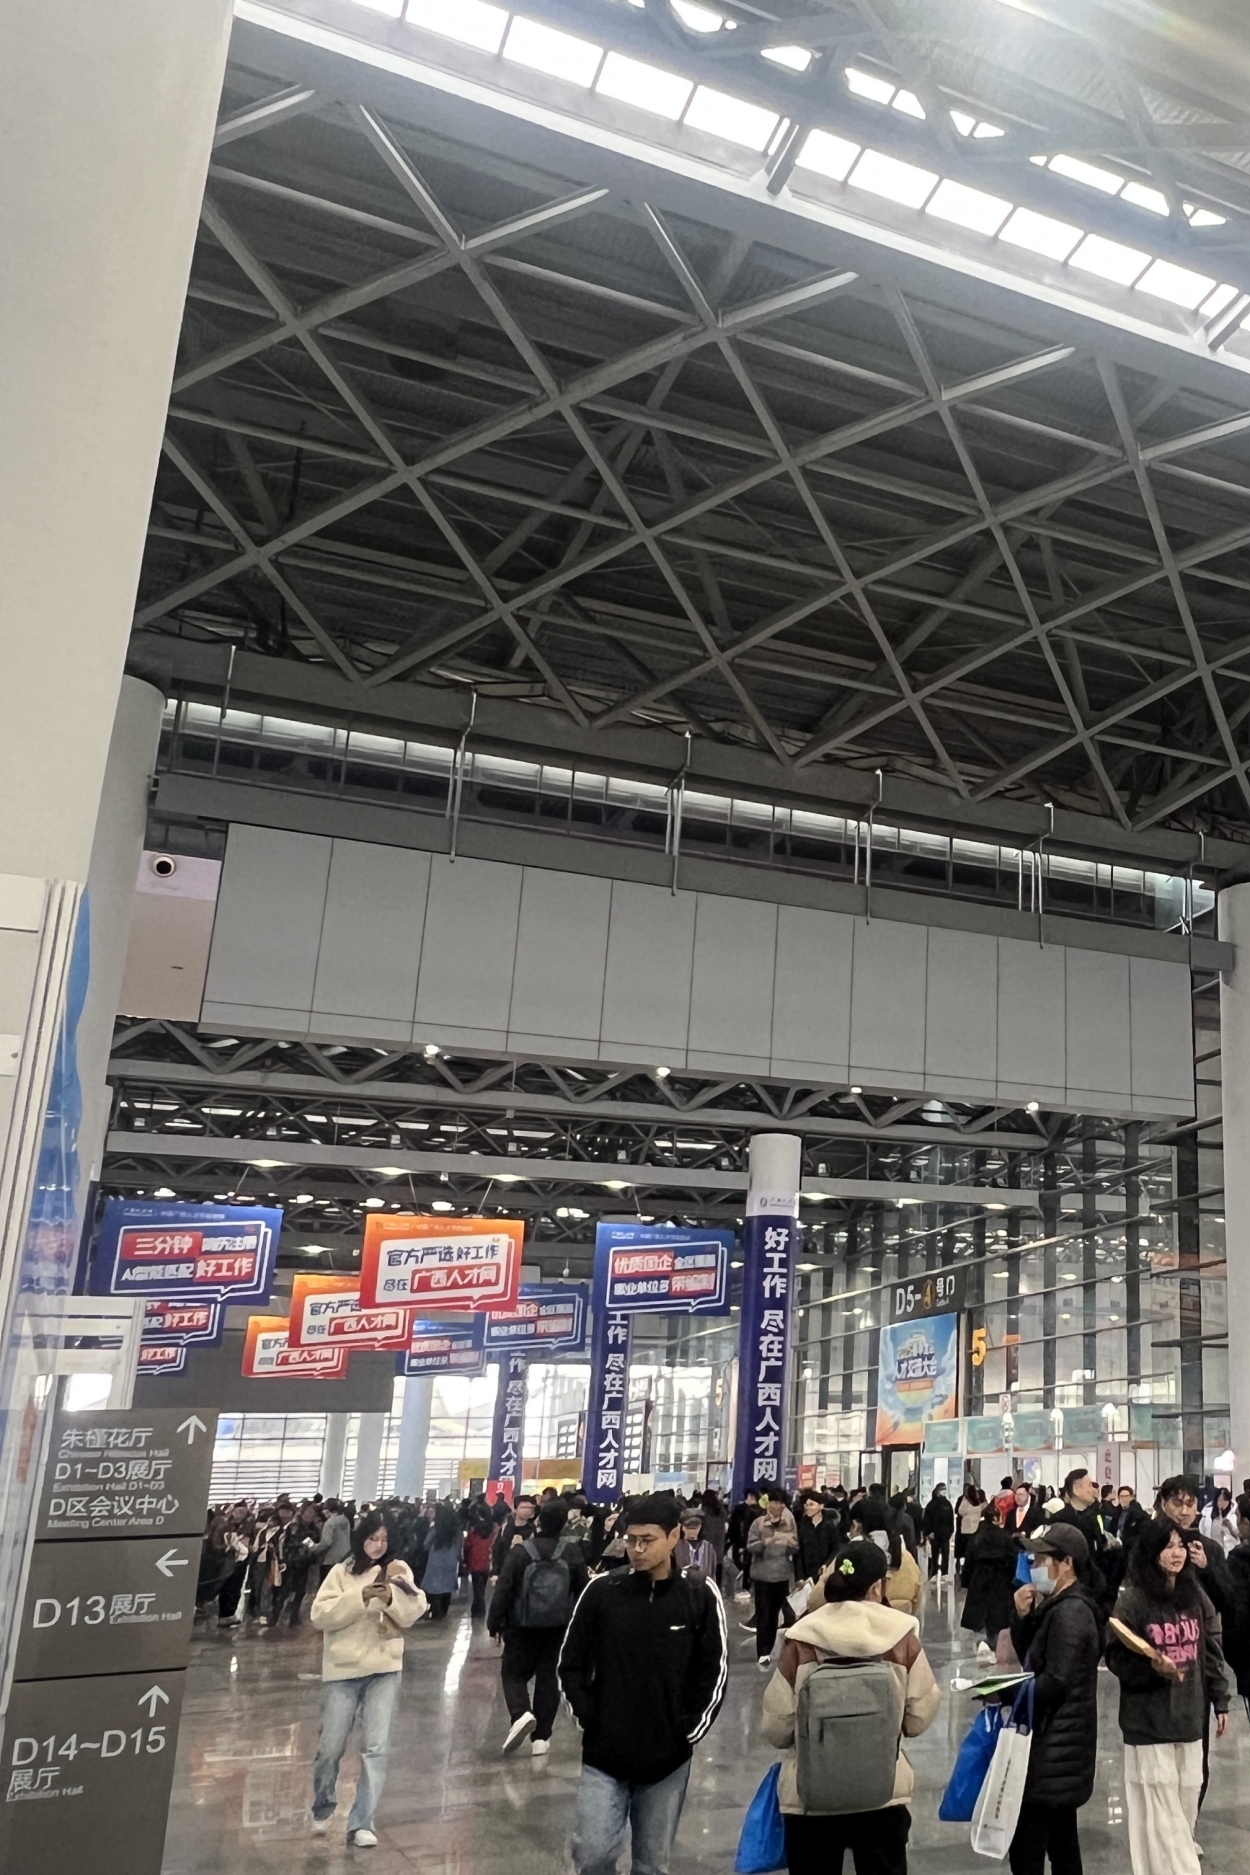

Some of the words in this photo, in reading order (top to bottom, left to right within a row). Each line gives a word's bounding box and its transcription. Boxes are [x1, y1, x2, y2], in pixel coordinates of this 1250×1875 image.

[134, 1235, 193, 1254] 三分钟
[195, 1257, 254, 1278] 好工作
[762, 1227, 789, 1298] 好工作
[413, 1265, 497, 1289] 广西人才网
[971, 1328, 987, 1366] 5
[753, 1310, 784, 1482] 尽在广西人才网
[597, 1354, 624, 1488] 尽在广西人才网
[49, 1494, 180, 1517] D区会议中心
[155, 1516, 165, 1525] D
[11, 1726, 166, 1765] D14~D15
[9, 1767, 61, 1792] 展厅
